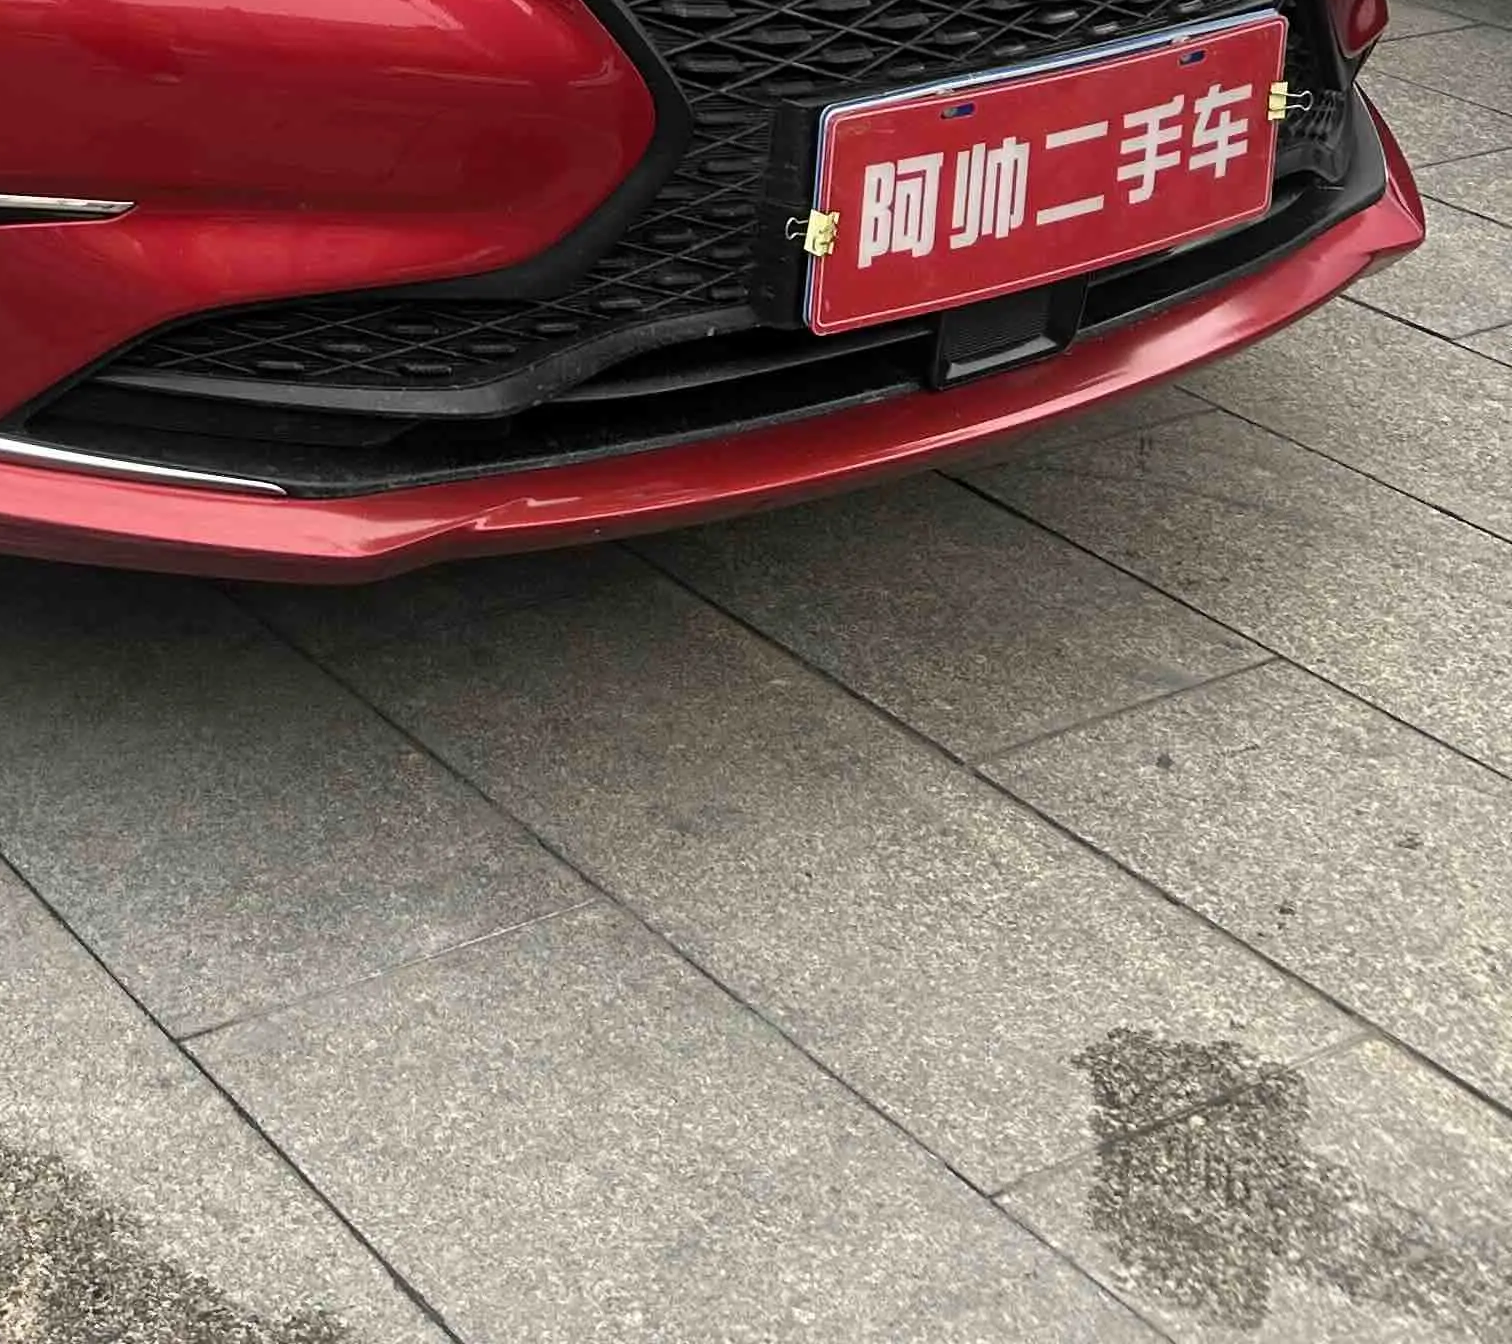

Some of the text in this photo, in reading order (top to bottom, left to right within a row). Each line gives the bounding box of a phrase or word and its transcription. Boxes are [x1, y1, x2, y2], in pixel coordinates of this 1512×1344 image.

[856, 83, 1253, 269] 阿帅二手车
